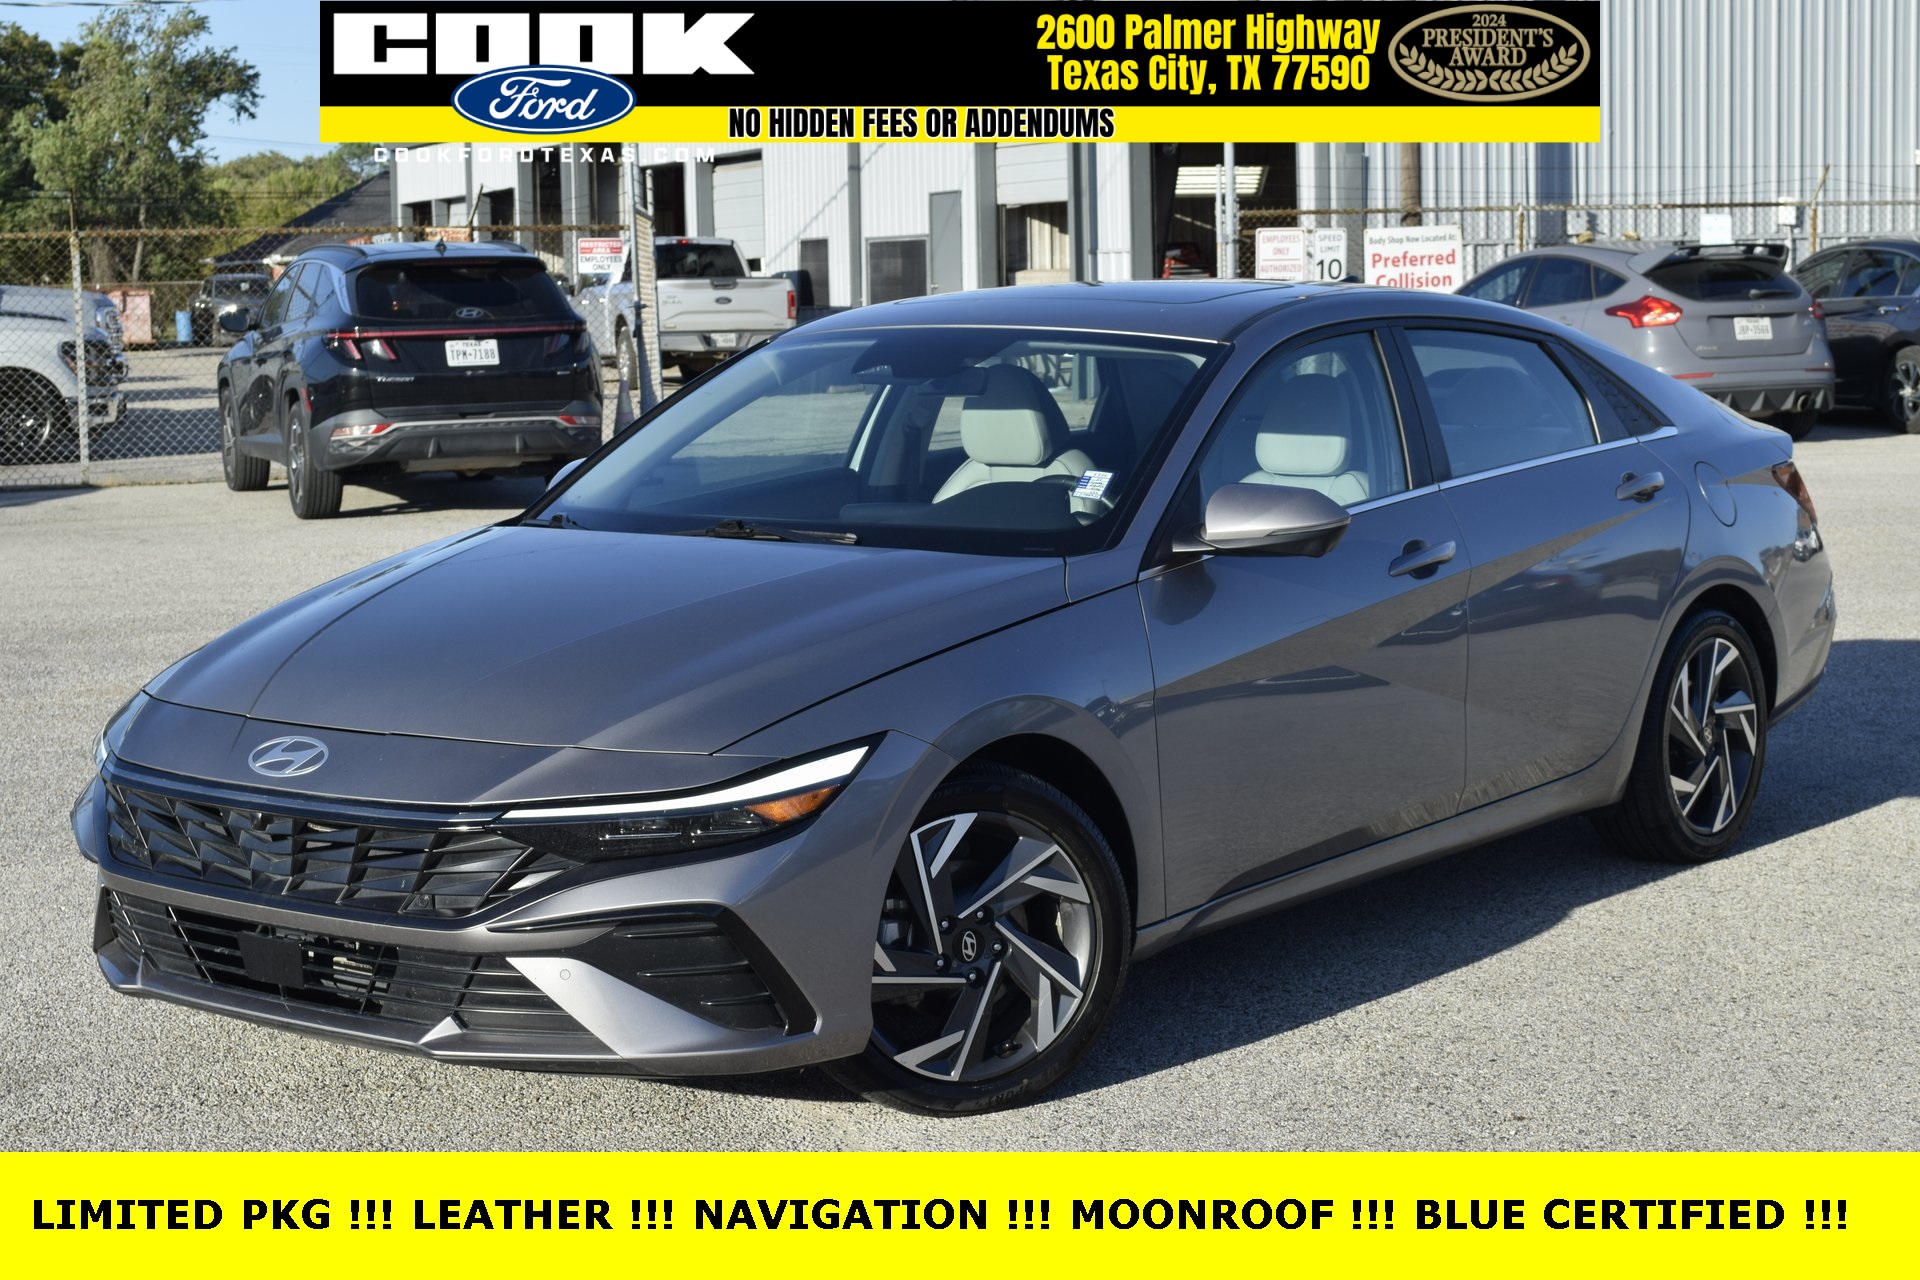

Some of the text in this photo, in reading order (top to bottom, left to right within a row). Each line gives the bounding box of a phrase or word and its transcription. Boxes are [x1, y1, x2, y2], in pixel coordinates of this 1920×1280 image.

[1262, 234, 1300, 243] EMPLOYEES
[1319, 234, 1343, 242] SPEED
[1369, 237, 1386, 246] Body
[1387, 235, 1404, 245] Shop
[1421, 232, 1447, 242] Located
[1273, 247, 1290, 255] ONLY
[1320, 245, 1340, 253] LIMIT
[1372, 249, 1456, 268] Preferred
[1261, 264, 1302, 273] AUTHORIZED
[1316, 259, 1342, 280] 10
[1376, 271, 1452, 288] Collision
